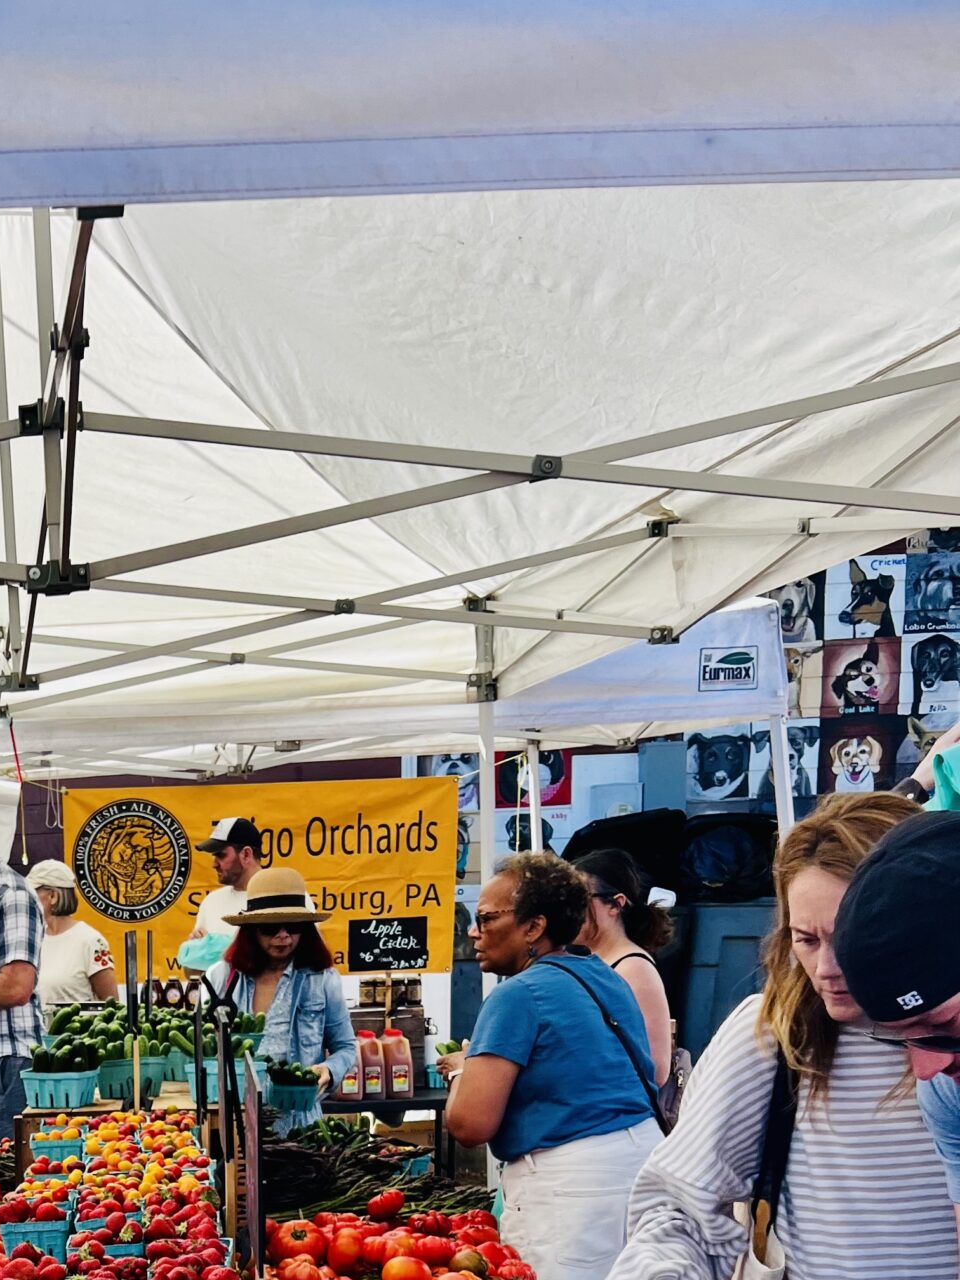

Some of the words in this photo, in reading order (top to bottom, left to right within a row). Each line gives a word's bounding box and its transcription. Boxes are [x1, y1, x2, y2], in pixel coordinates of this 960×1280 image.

[904, 623, 926, 631] Lobo
[702, 665, 751, 681] Eurmax
[76, 836, 89, 865] 100%
[85, 805, 119, 834] FRESH
[130, 802, 154, 815] ALL
[155, 809, 189, 861] NATURAL
[305, 810, 439, 857] Orchards
[80, 879, 106, 910] GOOD
[107, 906, 131, 920] FOR
[134, 905, 160, 919] YOU
[160, 876, 184, 907] FOOD
[405, 883, 442, 908] PA
[361, 919, 403, 938] Apple
